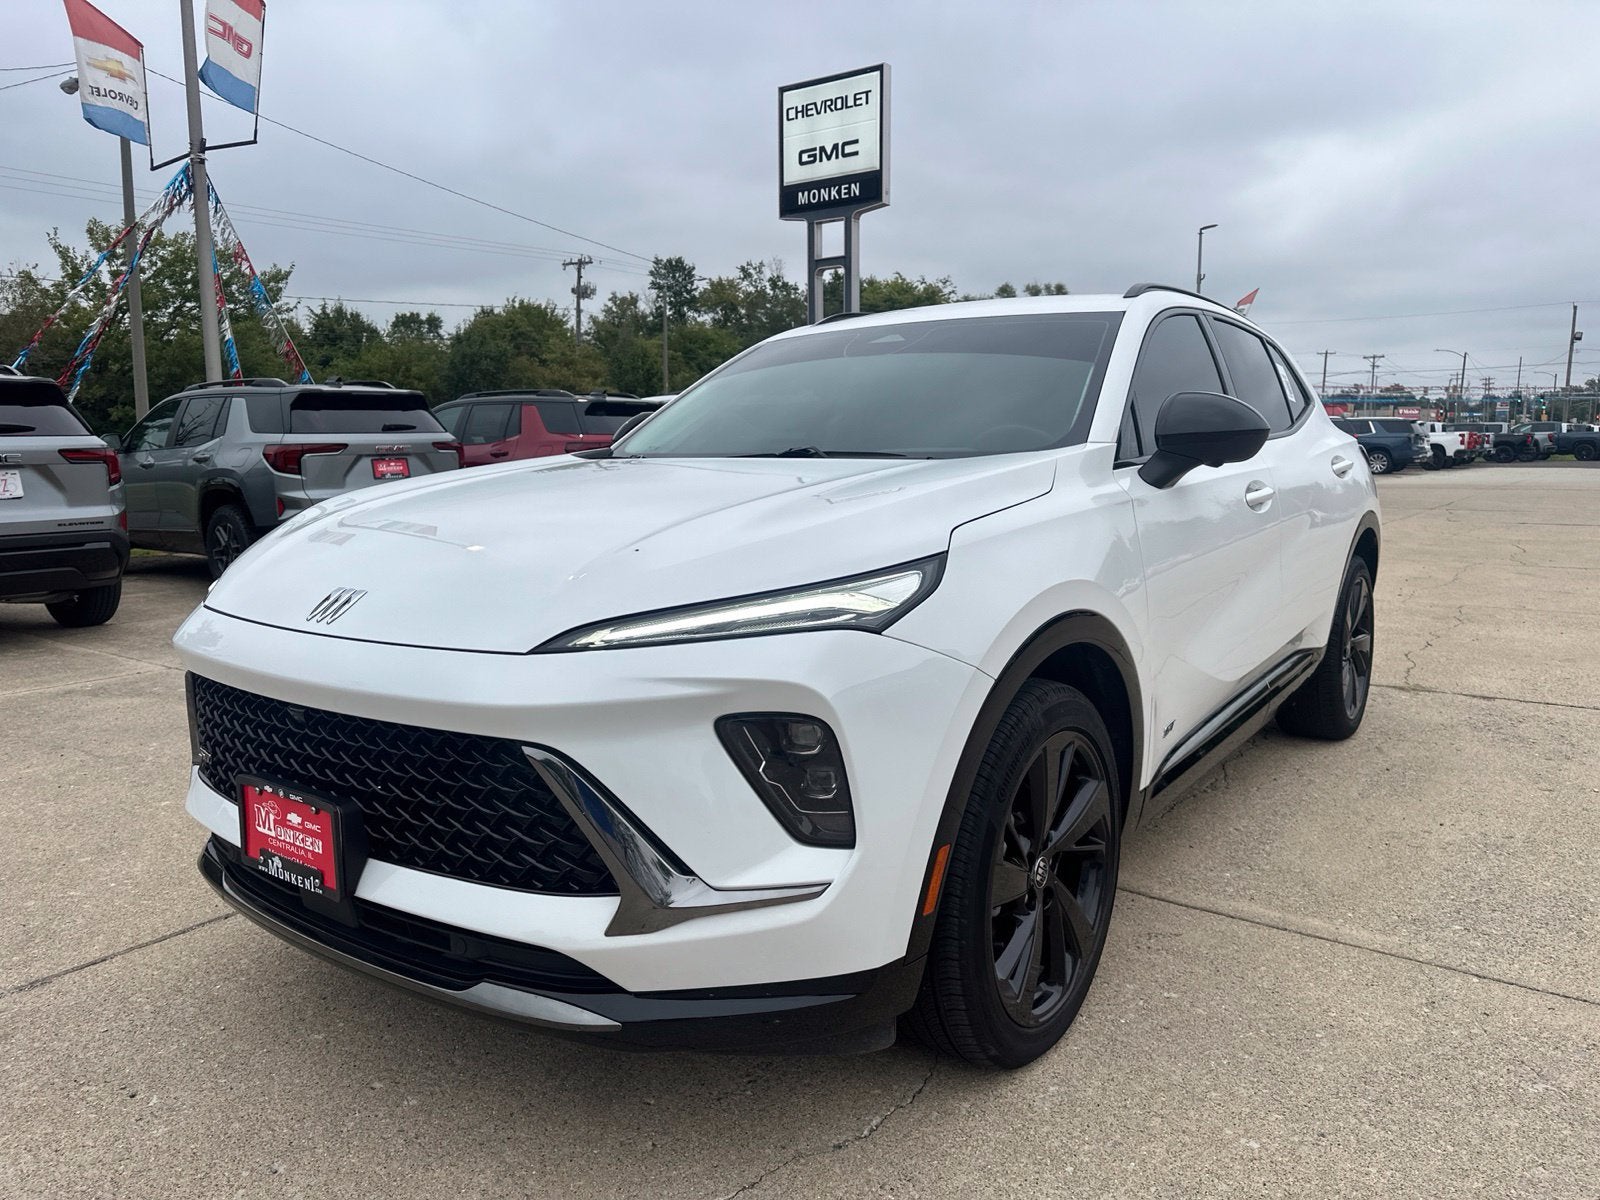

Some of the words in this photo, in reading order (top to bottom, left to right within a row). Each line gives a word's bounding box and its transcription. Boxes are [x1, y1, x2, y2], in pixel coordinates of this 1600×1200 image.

[786, 89, 872, 122] CHEVROLET
[798, 138, 860, 166] GMC
[798, 182, 860, 205] MONKEN
[289, 793, 303, 803] GMC
[304, 821, 321, 833] GMC
[307, 851, 314, 860] IL
